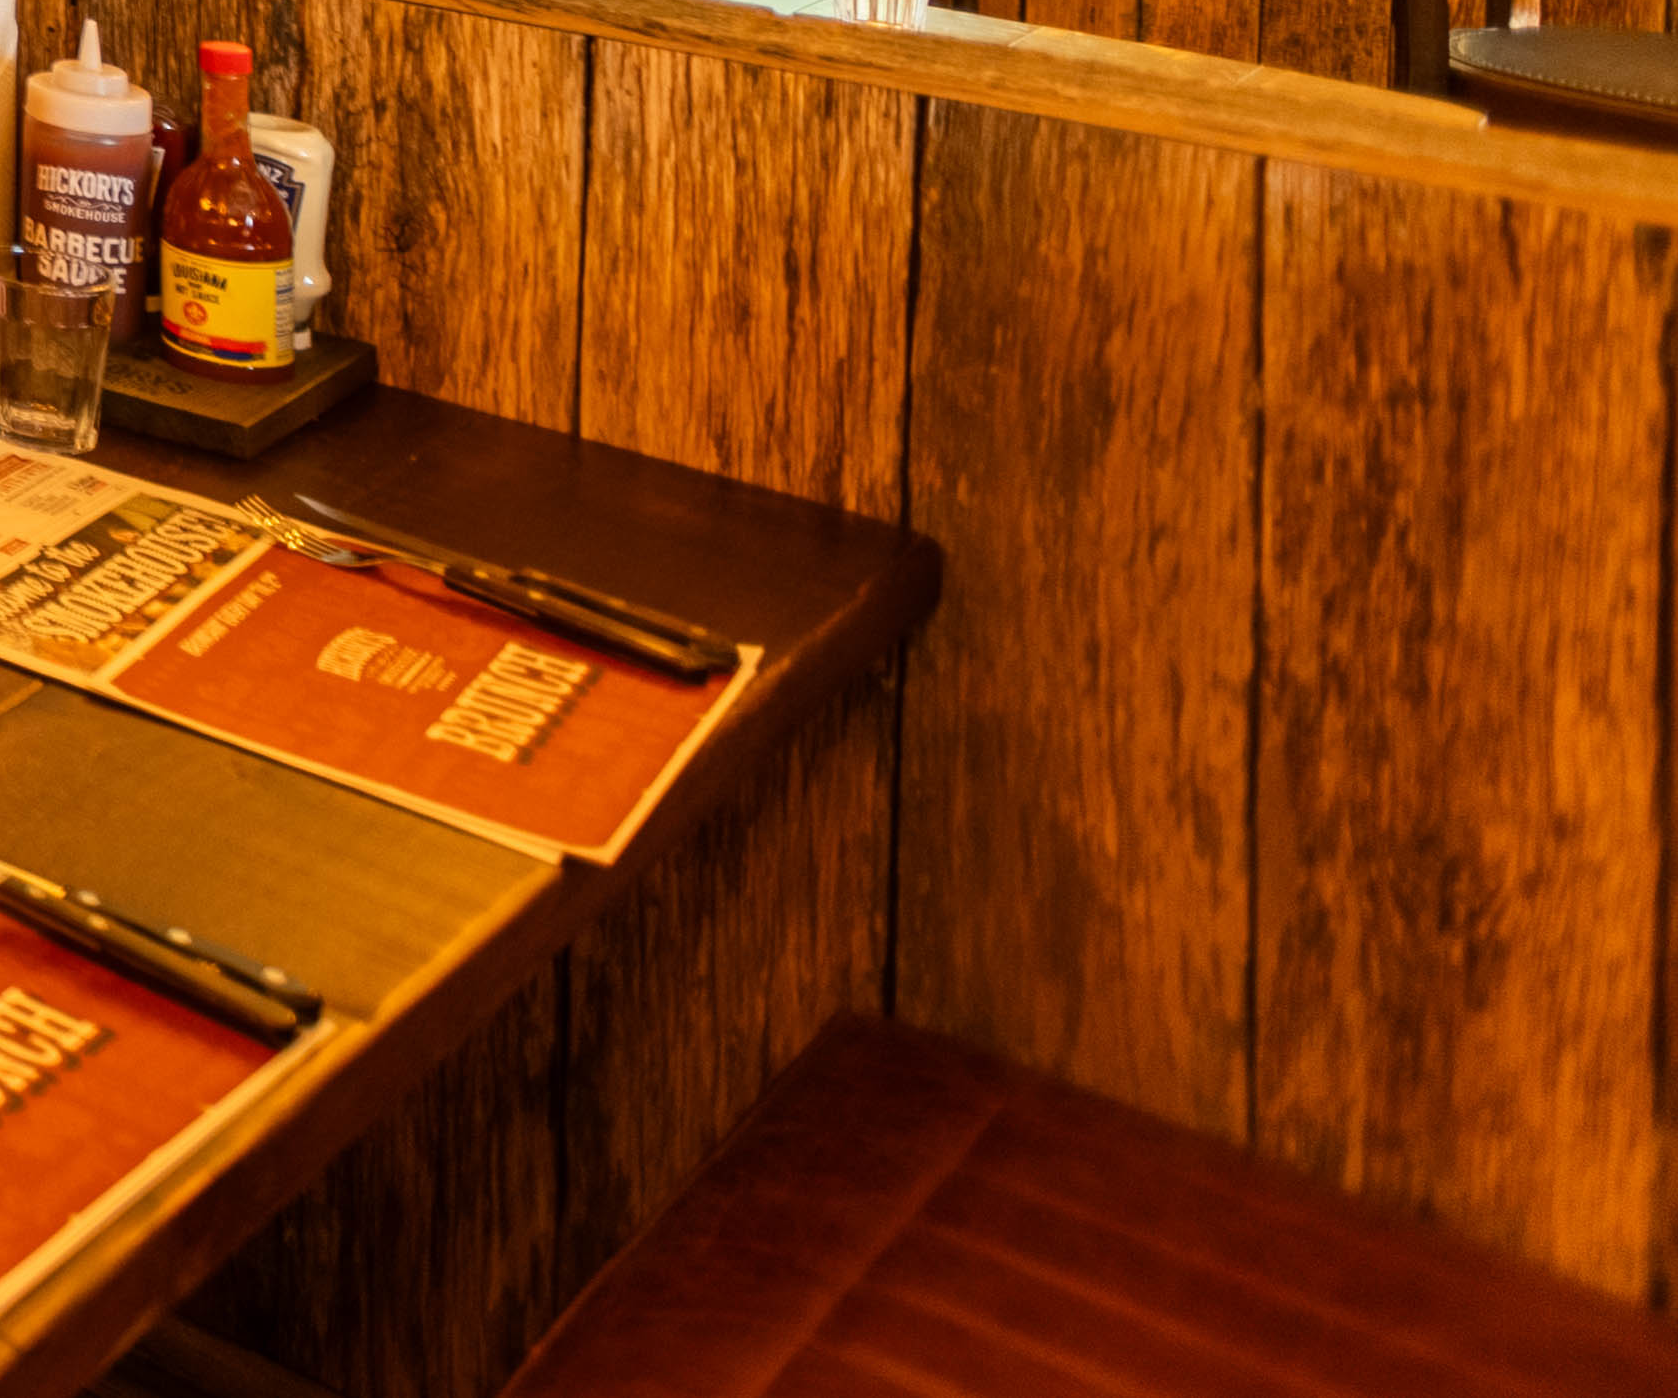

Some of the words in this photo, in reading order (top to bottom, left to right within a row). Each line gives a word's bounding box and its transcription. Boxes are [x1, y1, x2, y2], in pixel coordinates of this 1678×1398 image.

[37, 164, 135, 206] HICKORY'S
[44, 199, 126, 223] SMOKEHOUSE
[24, 216, 143, 264] BARBECUE
[425, 641, 590, 763] BRUNCH
